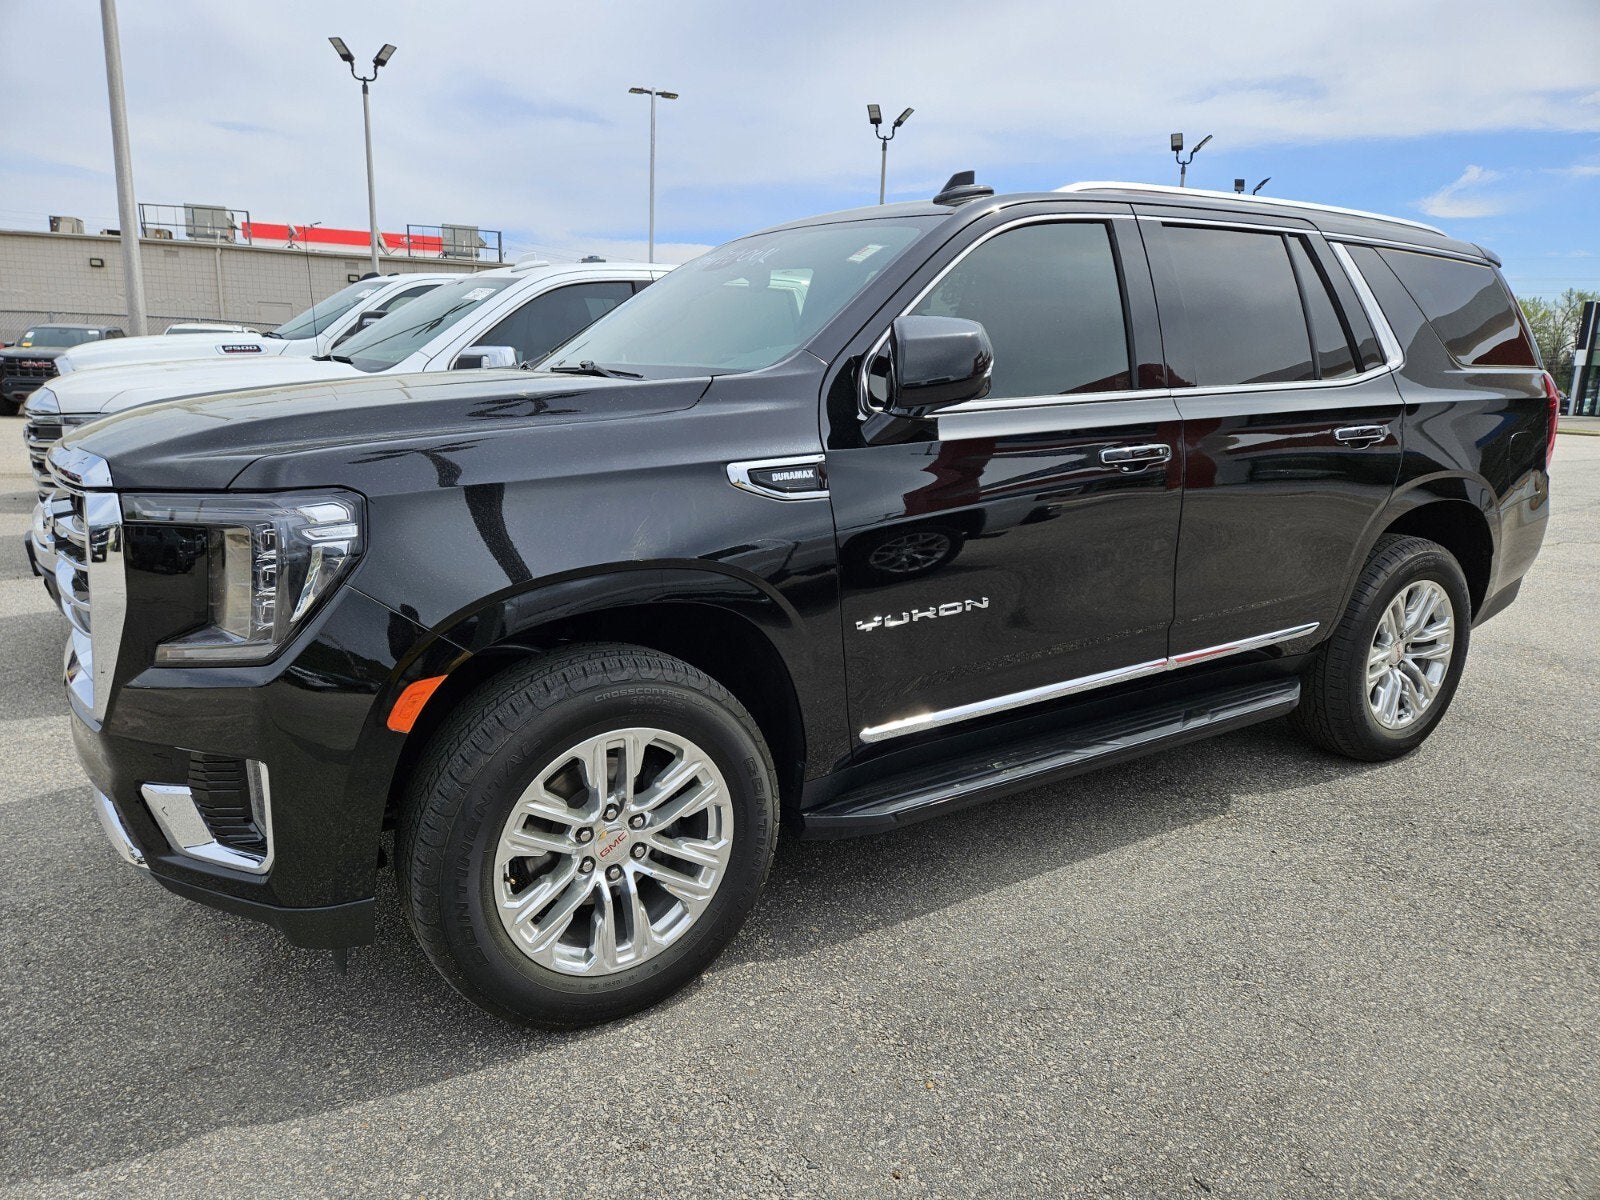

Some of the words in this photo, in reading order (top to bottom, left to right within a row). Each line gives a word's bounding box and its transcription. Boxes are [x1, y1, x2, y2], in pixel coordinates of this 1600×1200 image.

[22, 360, 52, 368] GMC
[772, 469, 815, 482] DURAMAX
[855, 596, 989, 632] YUKON
[594, 687, 689, 702] CROSSCONTACT
[600, 831, 627, 857] GMC
